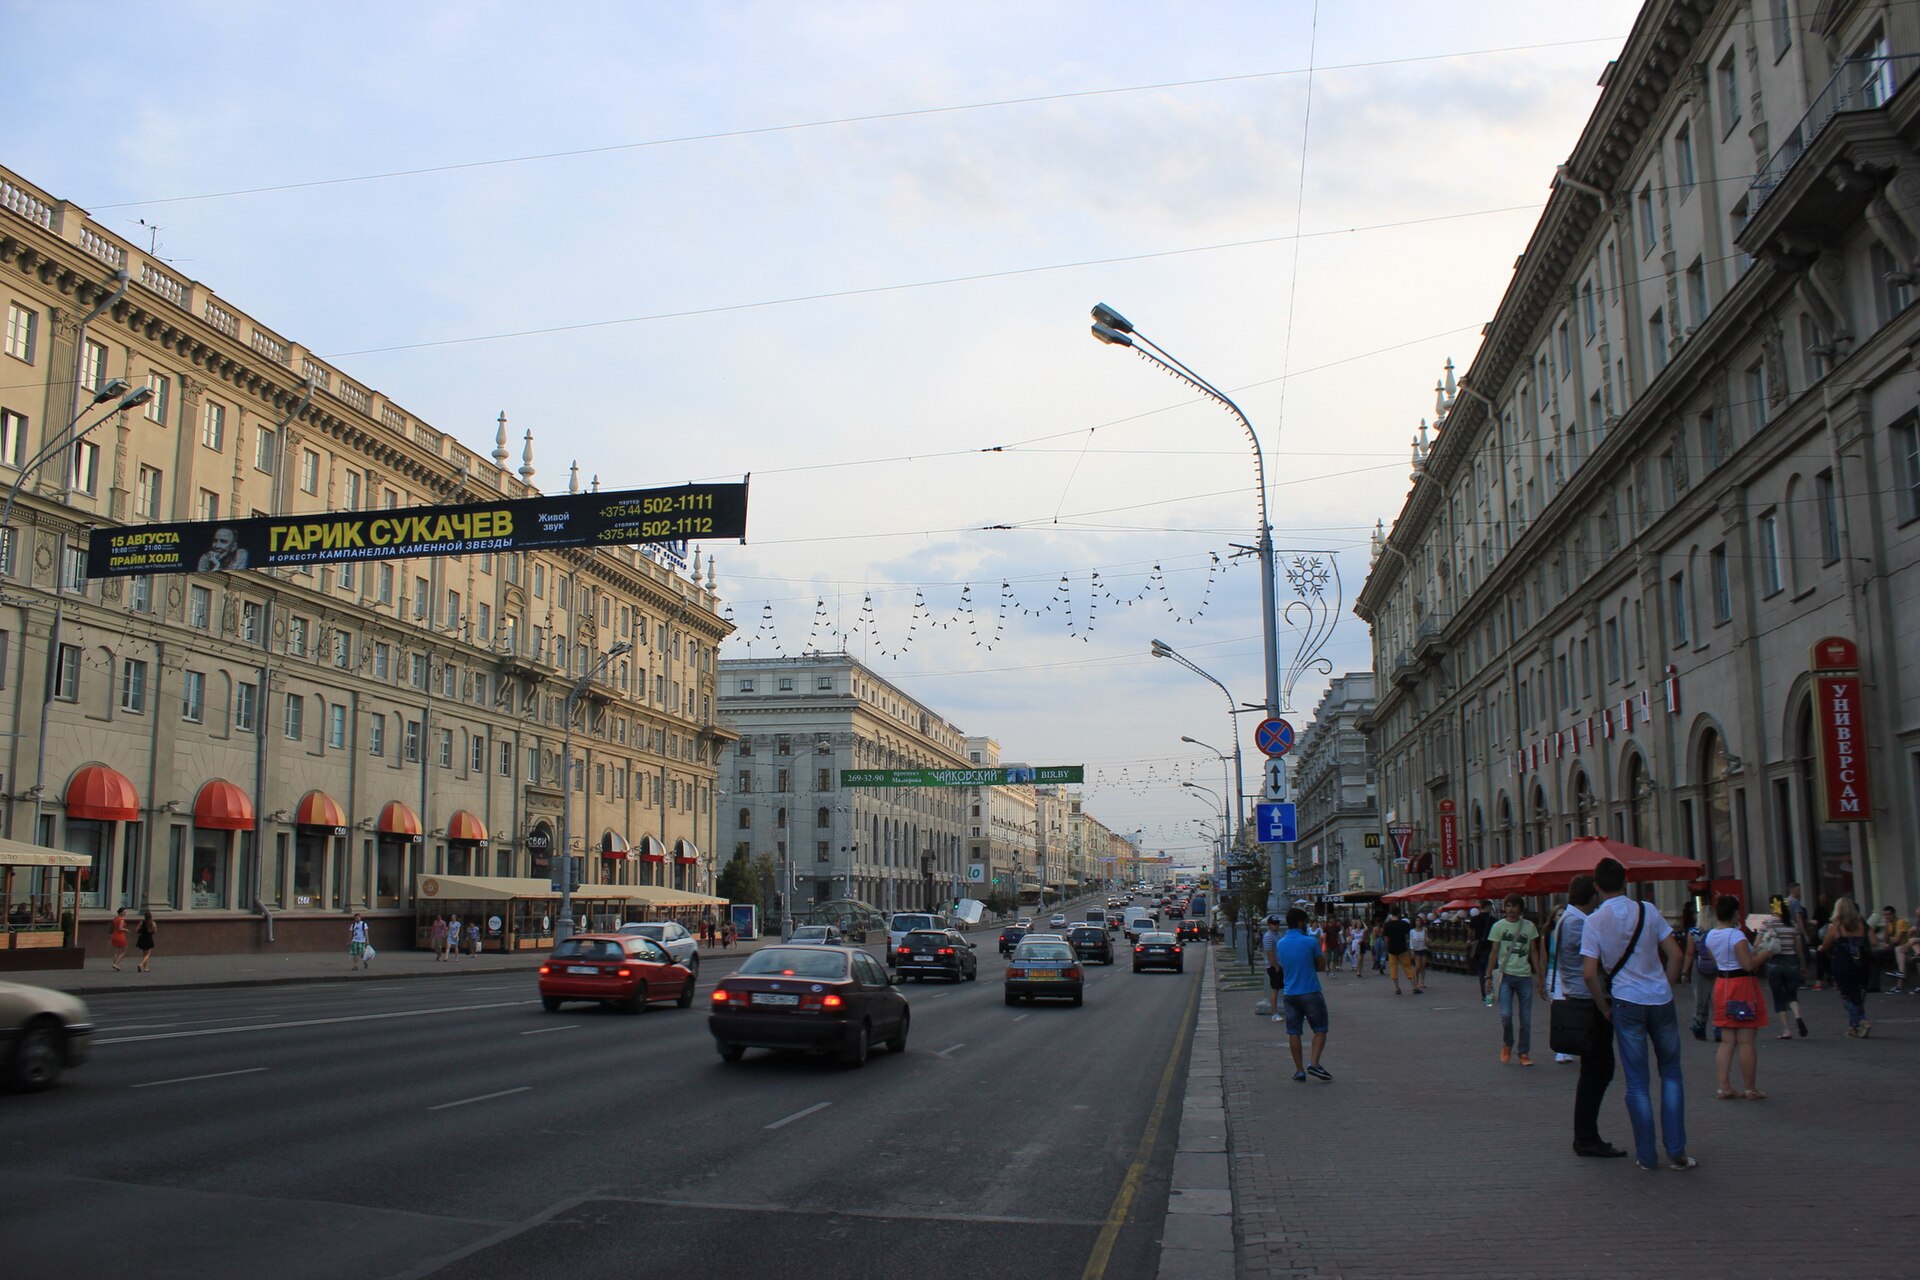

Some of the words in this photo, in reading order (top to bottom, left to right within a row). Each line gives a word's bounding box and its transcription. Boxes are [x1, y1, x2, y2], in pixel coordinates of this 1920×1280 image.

[599, 505, 626, 518] +375
[628, 505, 641, 515] 44
[643, 494, 713, 514] 502-1111
[538, 511, 570, 522] Живой
[270, 521, 365, 552] ГАРИК
[369, 510, 514, 545] СУКАЧЕВ
[543, 523, 564, 532] звук
[597, 528, 625, 540] +375
[626, 528, 640, 538] 44
[642, 517, 713, 538] 502-1112
[111, 536, 124, 547] 15
[126, 532, 180, 546] АВГУСТА
[110, 554, 146, 566] ПРАЙМ
[148, 553, 179, 563] ХОЛЛ
[277, 553, 317, 562] ОРКЕСТР
[319, 547, 396, 559] КАМПАНЕЛЛА
[399, 541, 463, 554] КАМЕННОЙ
[465, 538, 513, 550] ЗВЕЗДЫ
[1832, 684, 1860, 812] УНИВЕРСАМ
[848, 774, 884, 782] 269-32-90
